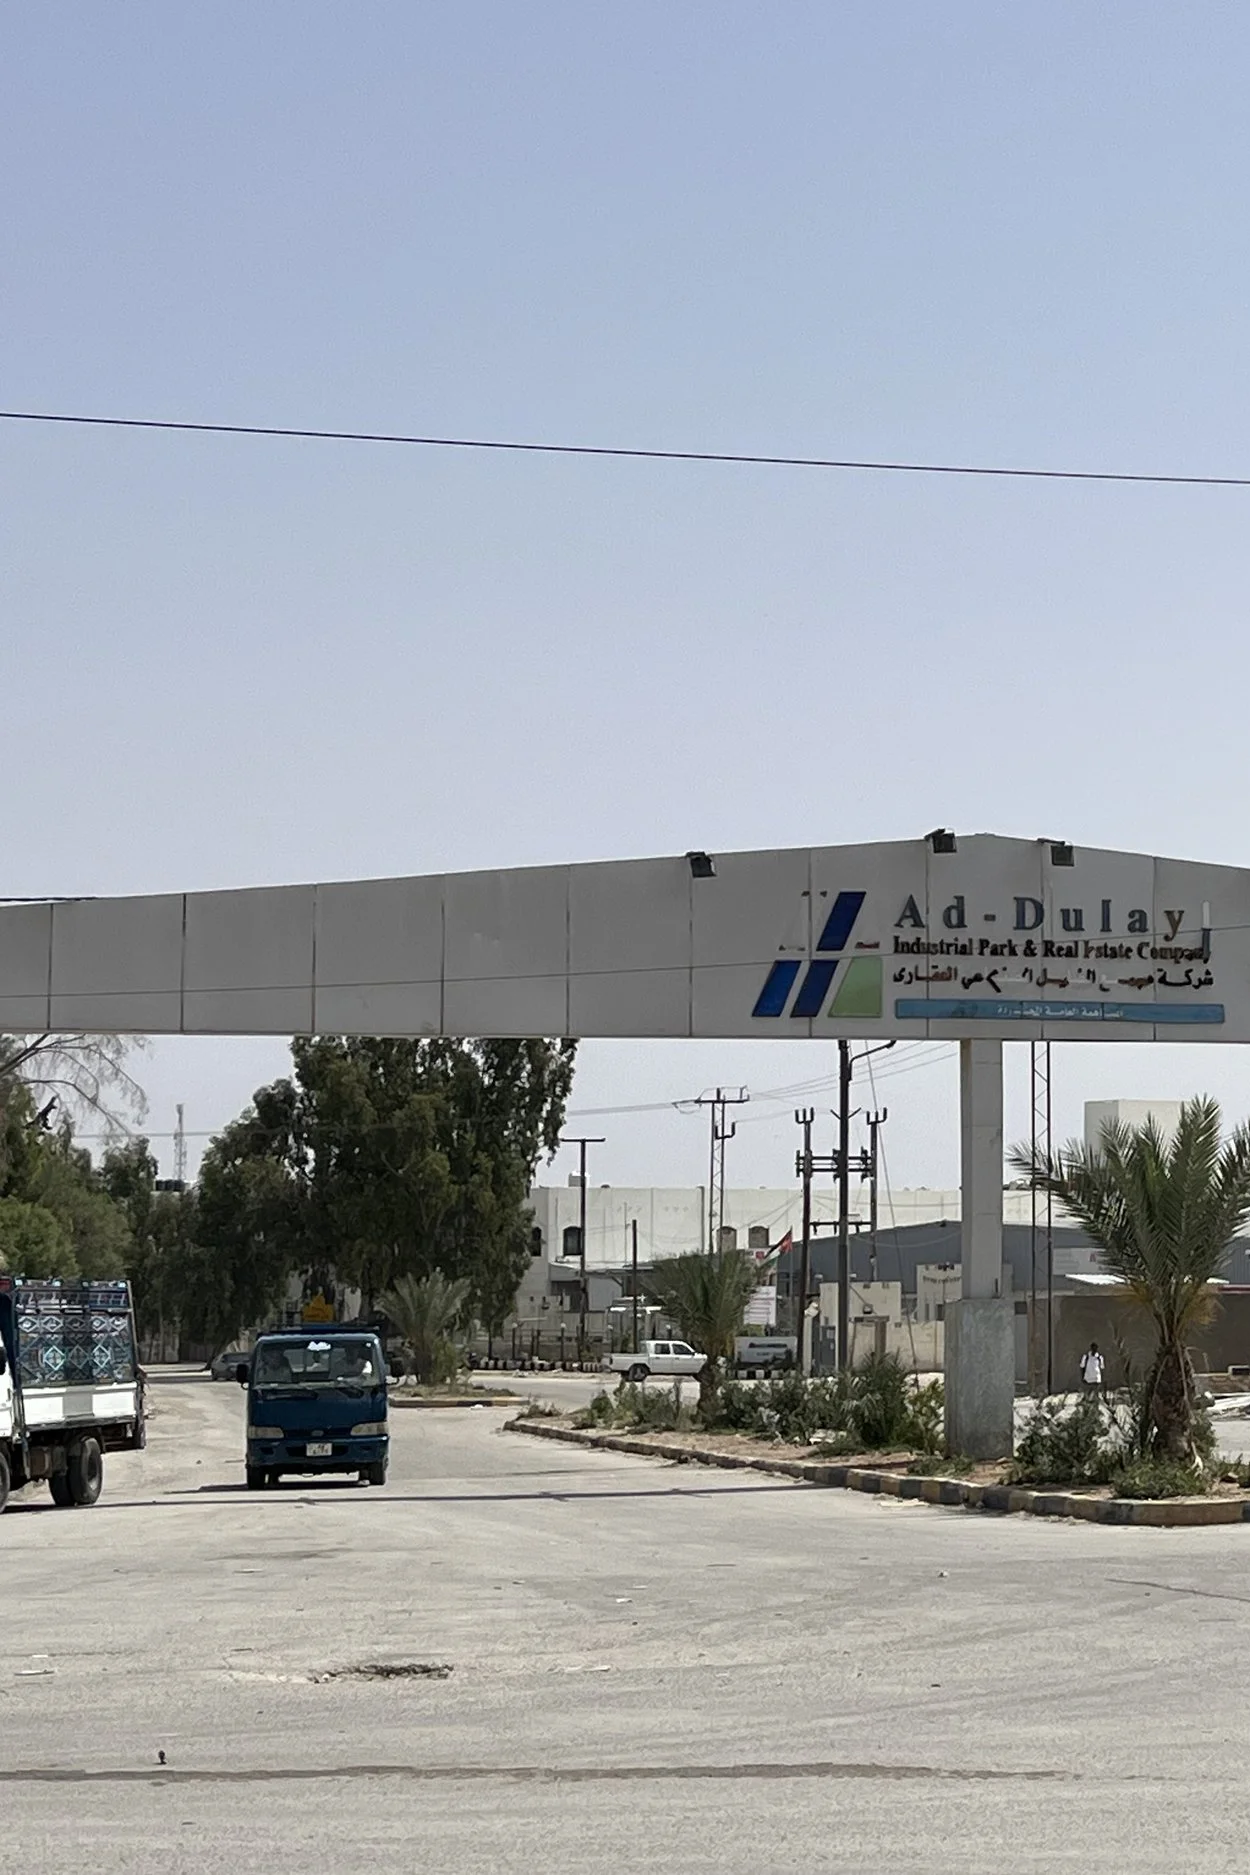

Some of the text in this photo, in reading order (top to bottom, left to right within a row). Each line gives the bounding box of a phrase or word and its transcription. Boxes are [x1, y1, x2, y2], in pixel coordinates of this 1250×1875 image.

[893, 935, 973, 956] Industrial
[978, 938, 1018, 957] Park
[1023, 939, 1038, 958] &
[1043, 939, 1078, 959] Real
[1157, 967, 1214, 989] شركة
